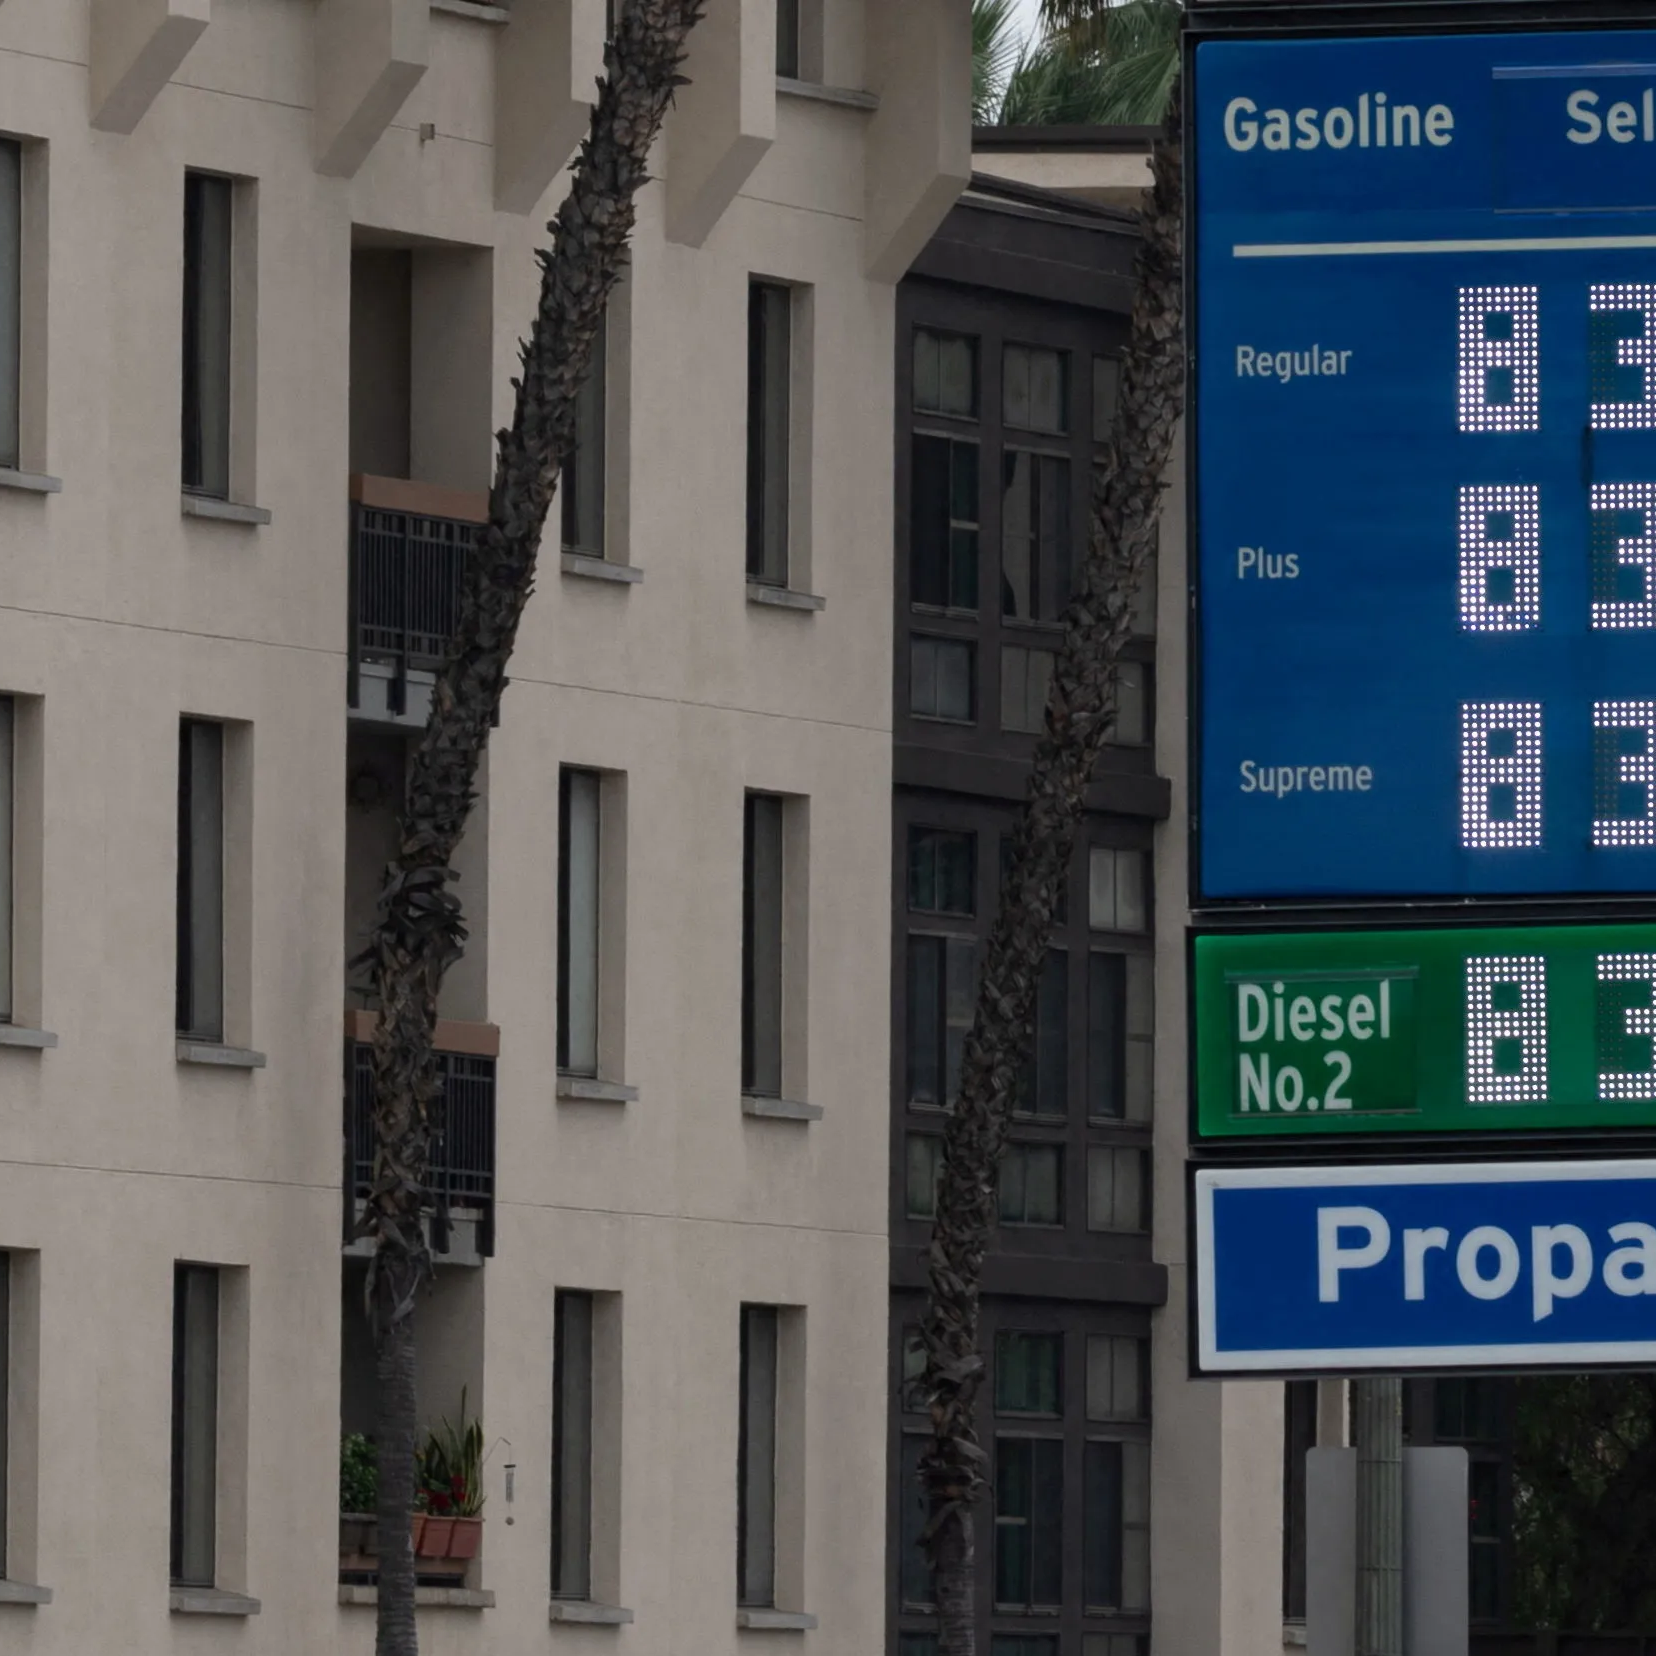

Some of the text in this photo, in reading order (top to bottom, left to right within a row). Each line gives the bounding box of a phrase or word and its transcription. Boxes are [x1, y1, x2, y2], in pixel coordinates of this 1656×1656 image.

[1224, 92, 1455, 153] Gasoline
[1235, 342, 1352, 384] Regular
[1237, 547, 1300, 581] Plus
[1238, 760, 1373, 799] Supreme
[1237, 978, 1392, 1043] Diesel
[1238, 1051, 1354, 1112] No.2
